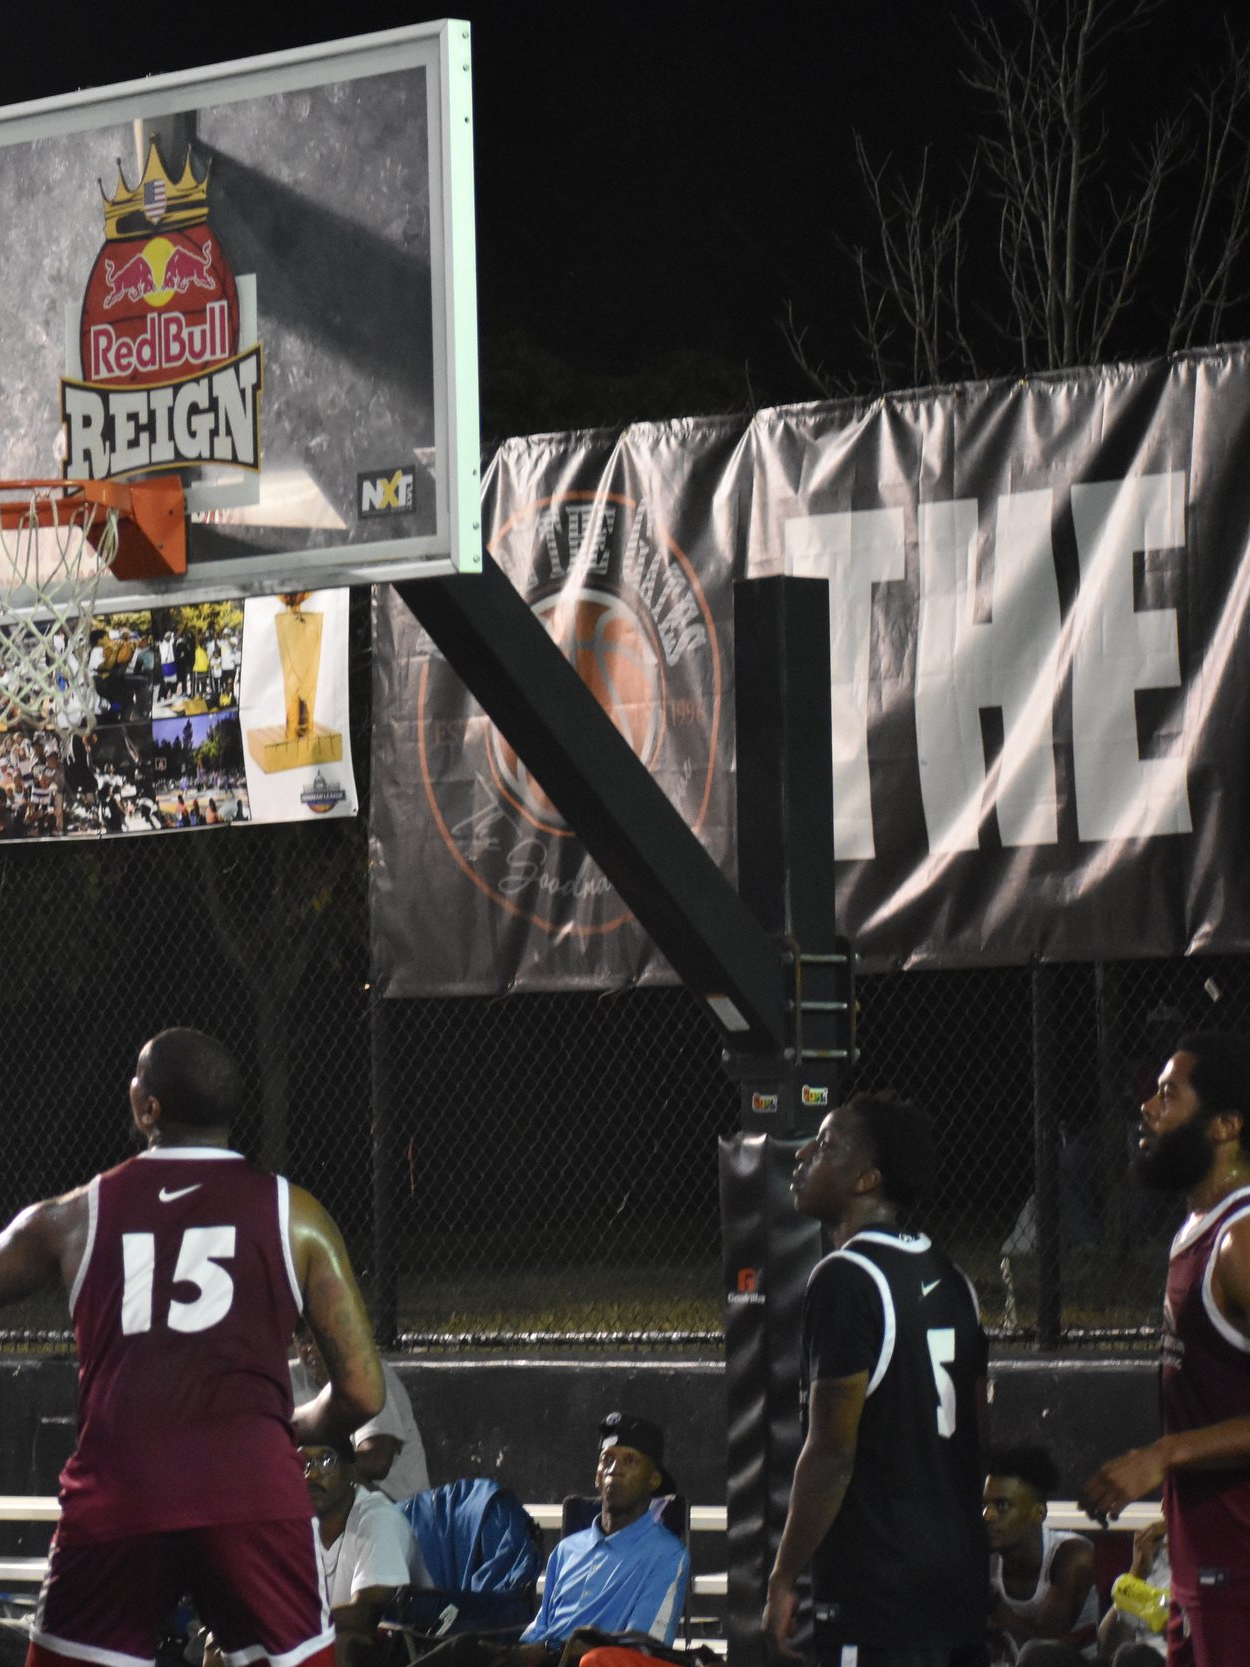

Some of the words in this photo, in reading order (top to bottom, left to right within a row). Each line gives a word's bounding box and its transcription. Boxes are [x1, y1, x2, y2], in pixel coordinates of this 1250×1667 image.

[91, 312, 159, 380] Red
[162, 301, 229, 369] Bull
[65, 354, 258, 482] REIGN
[362, 469, 413, 512] NXT
[785, 470, 1193, 862] THE
[498, 838, 614, 899] Goodma
[121, 1225, 236, 1335] 15
[926, 1328, 956, 1438] 5
